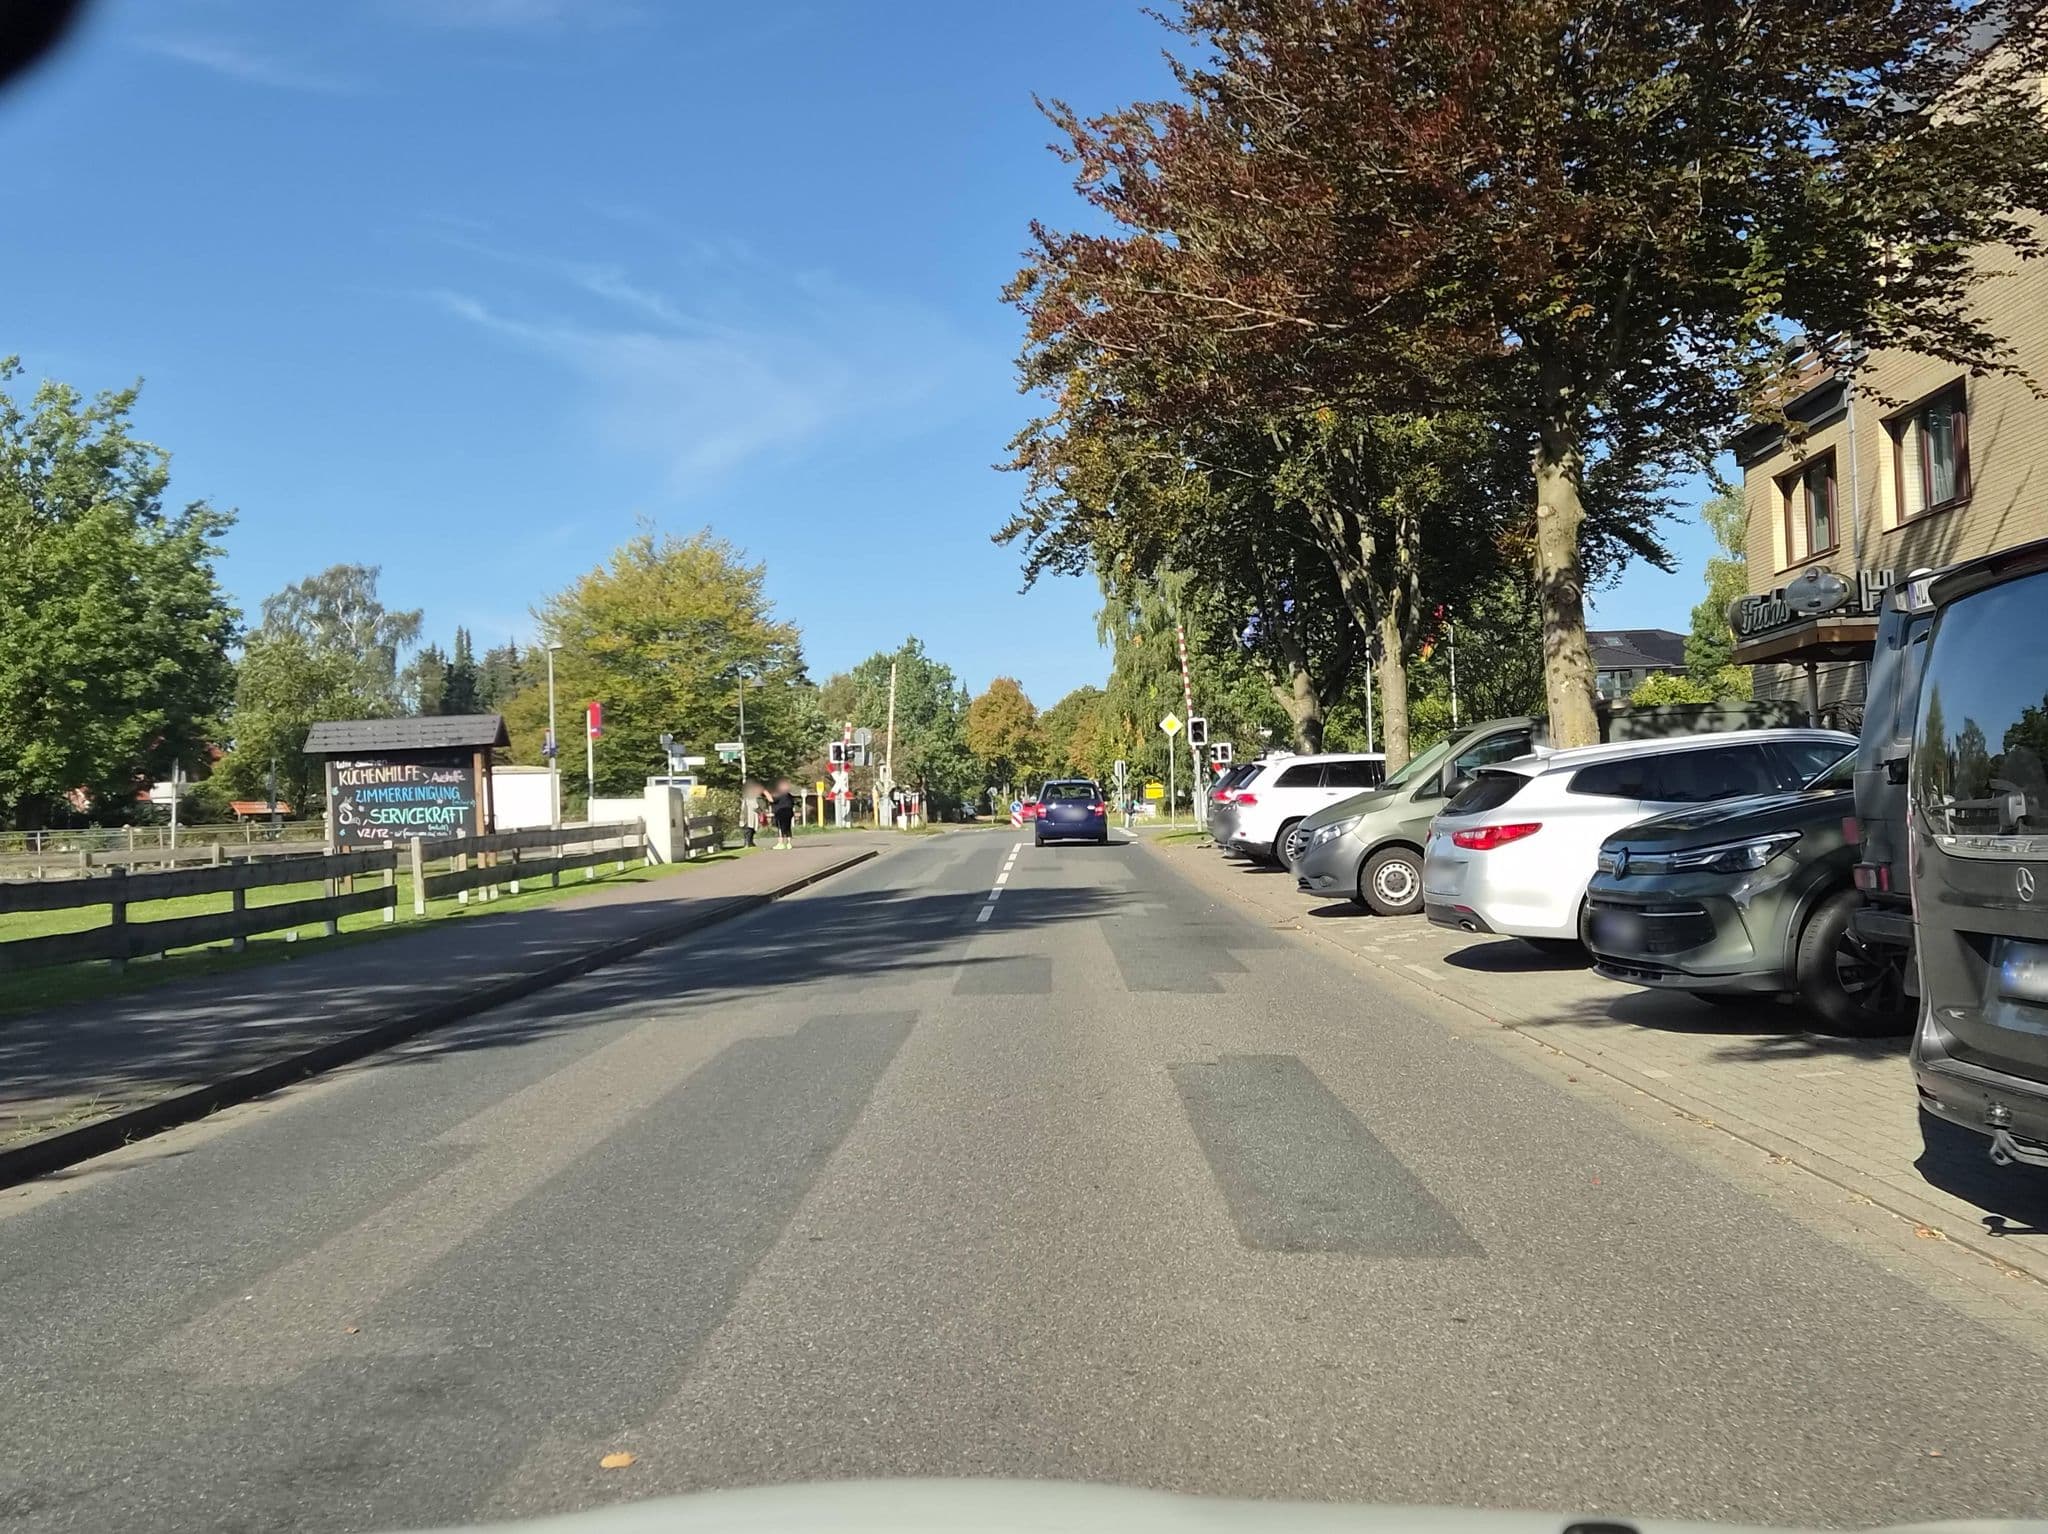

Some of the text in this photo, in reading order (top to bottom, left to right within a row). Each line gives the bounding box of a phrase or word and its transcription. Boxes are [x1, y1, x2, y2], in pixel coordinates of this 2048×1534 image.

[338, 765, 421, 786] KÜCHENHILFE
[355, 786, 461, 803] ZIMMERREINIGUNG
[368, 806, 469, 825] SERVICEKRAFT
